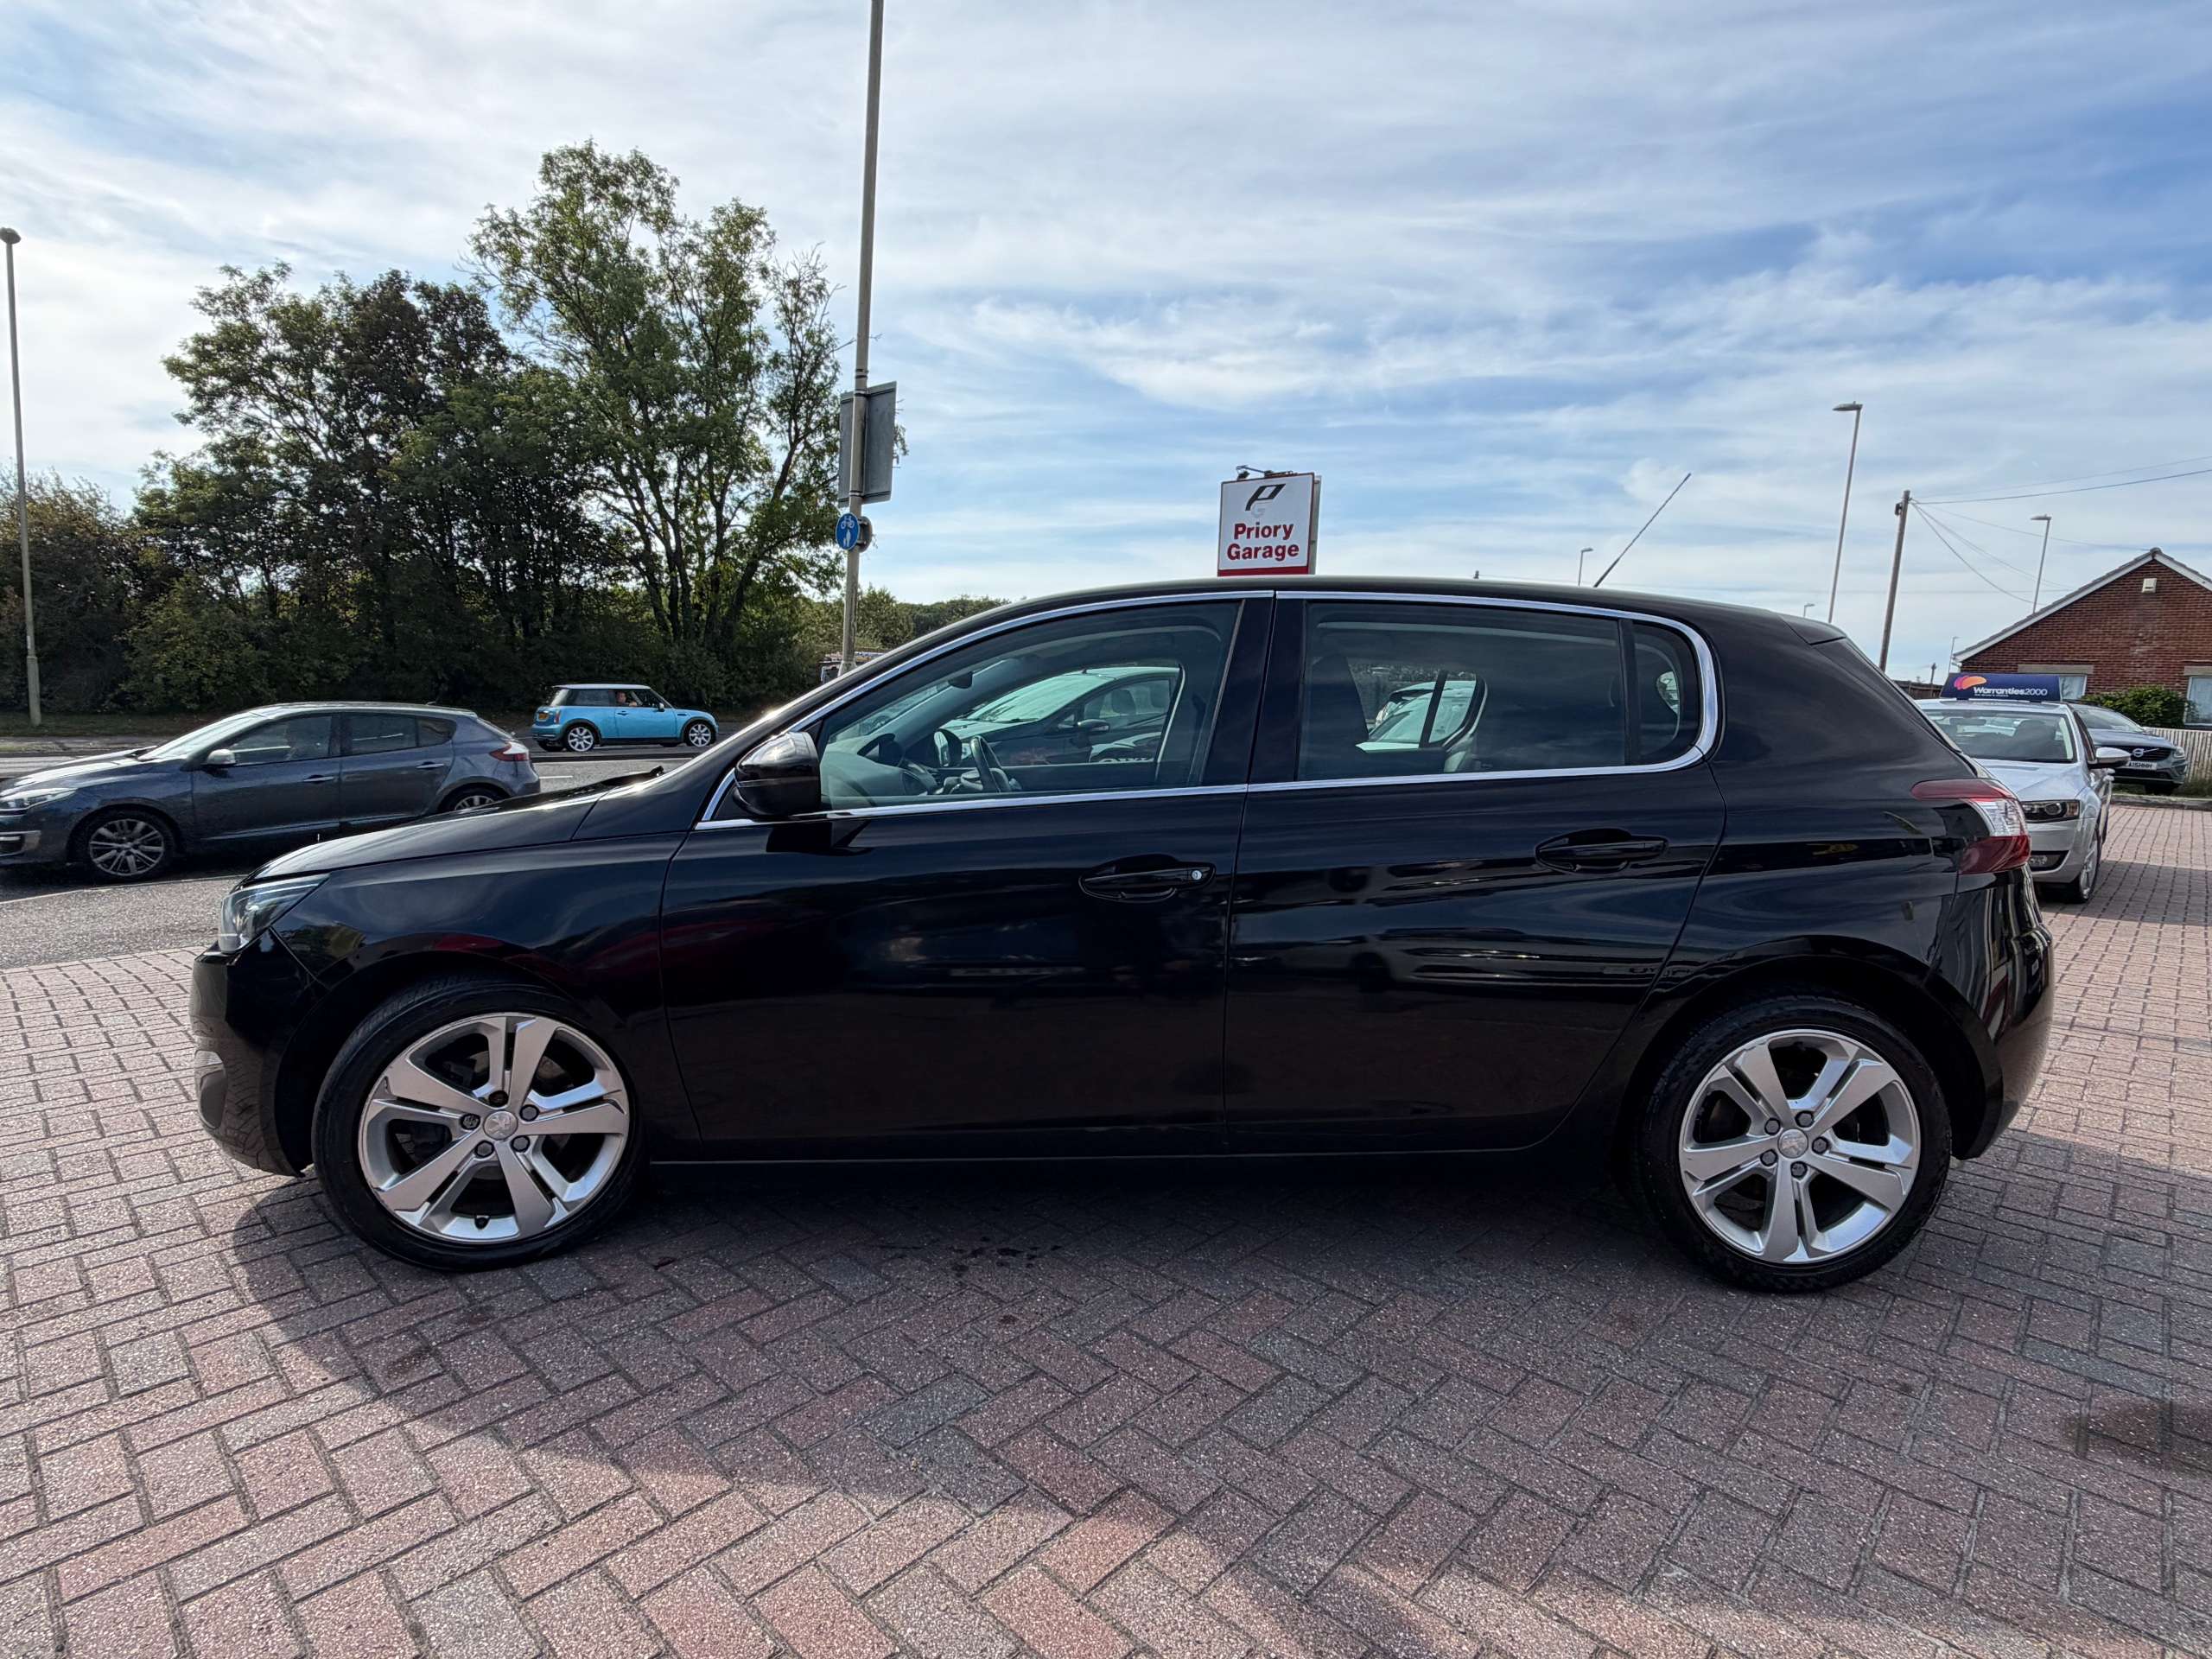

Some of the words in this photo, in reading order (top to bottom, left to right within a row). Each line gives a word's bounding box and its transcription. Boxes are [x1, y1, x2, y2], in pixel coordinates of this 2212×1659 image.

[1234, 521, 1294, 541] Priory
[1227, 543, 1300, 562] Garage
[1974, 686, 2047, 696] Warranties2000
